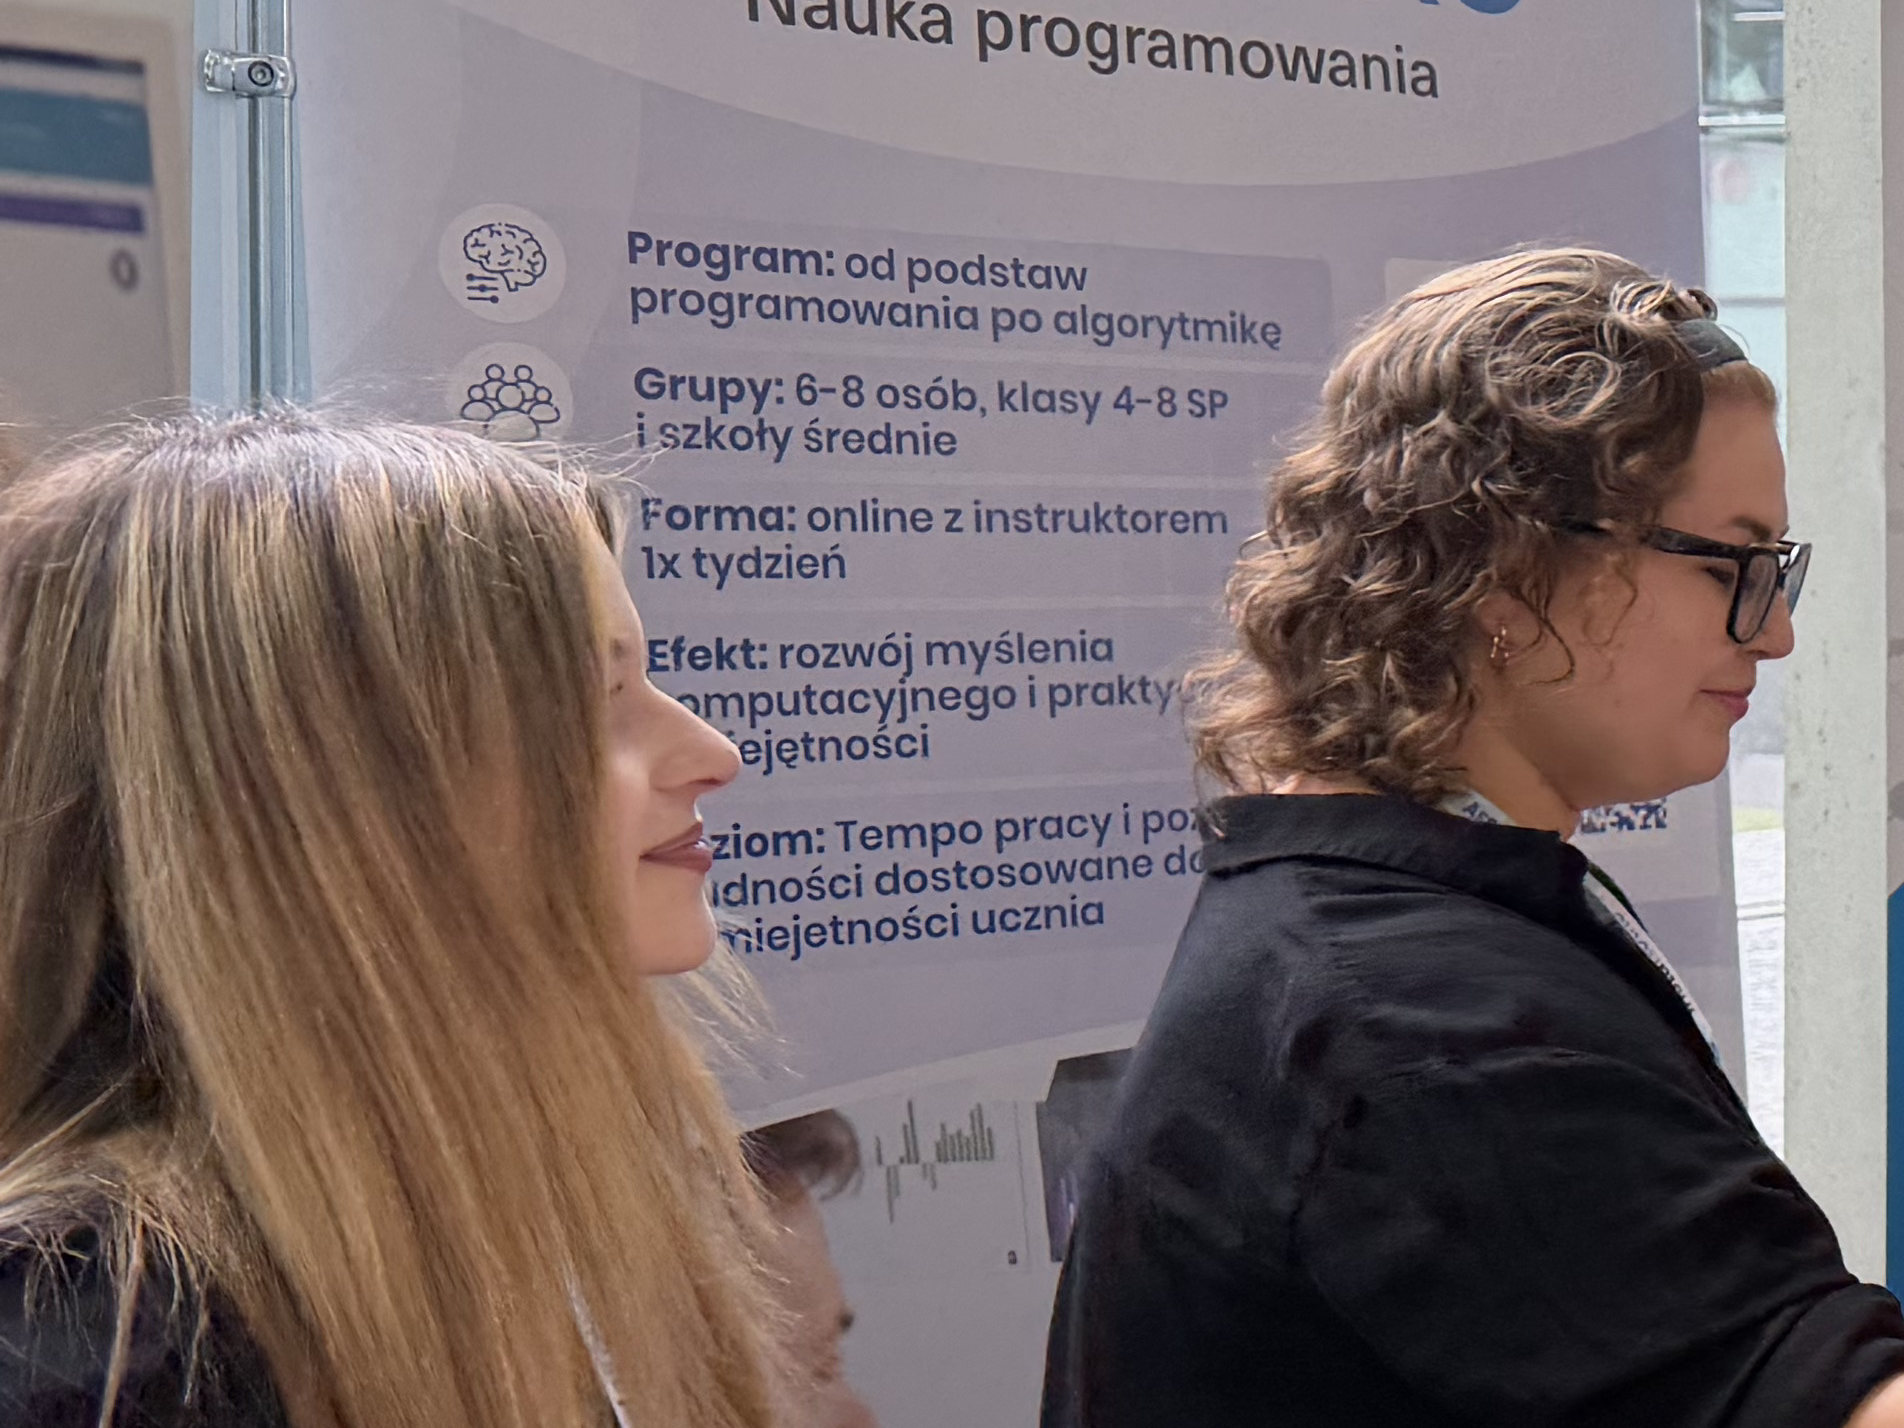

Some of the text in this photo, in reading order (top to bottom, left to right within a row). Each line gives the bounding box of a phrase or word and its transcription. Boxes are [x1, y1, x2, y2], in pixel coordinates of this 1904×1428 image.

[975, 5, 1441, 100] programowania
[626, 230, 1088, 295] Program: od podstaw
[629, 281, 1282, 352] programowania po algorytmikę
[633, 367, 786, 415] Grupy:
[876, 372, 988, 417] osób,
[997, 378, 1103, 424] klasy
[1187, 387, 1229, 421] SP
[636, 412, 958, 463] i szkoły średnie
[640, 497, 1229, 536] Forma: online z instruktorem
[642, 541, 846, 592] 1x tydzień
[646, 629, 1115, 678] Efekt: rozwój myślenia
[678, 675, 1176, 729] omputacyjnego i prakty
[733, 722, 930, 775] ejętności
[709, 822, 826, 861] ziom:
[834, 818, 984, 858] Tempo
[994, 813, 1111, 862] pracy
[1121, 805, 1132, 839] i
[711, 862, 864, 907] dności
[875, 848, 1153, 898] dostosowane
[971, 896, 1106, 935] ucznia
